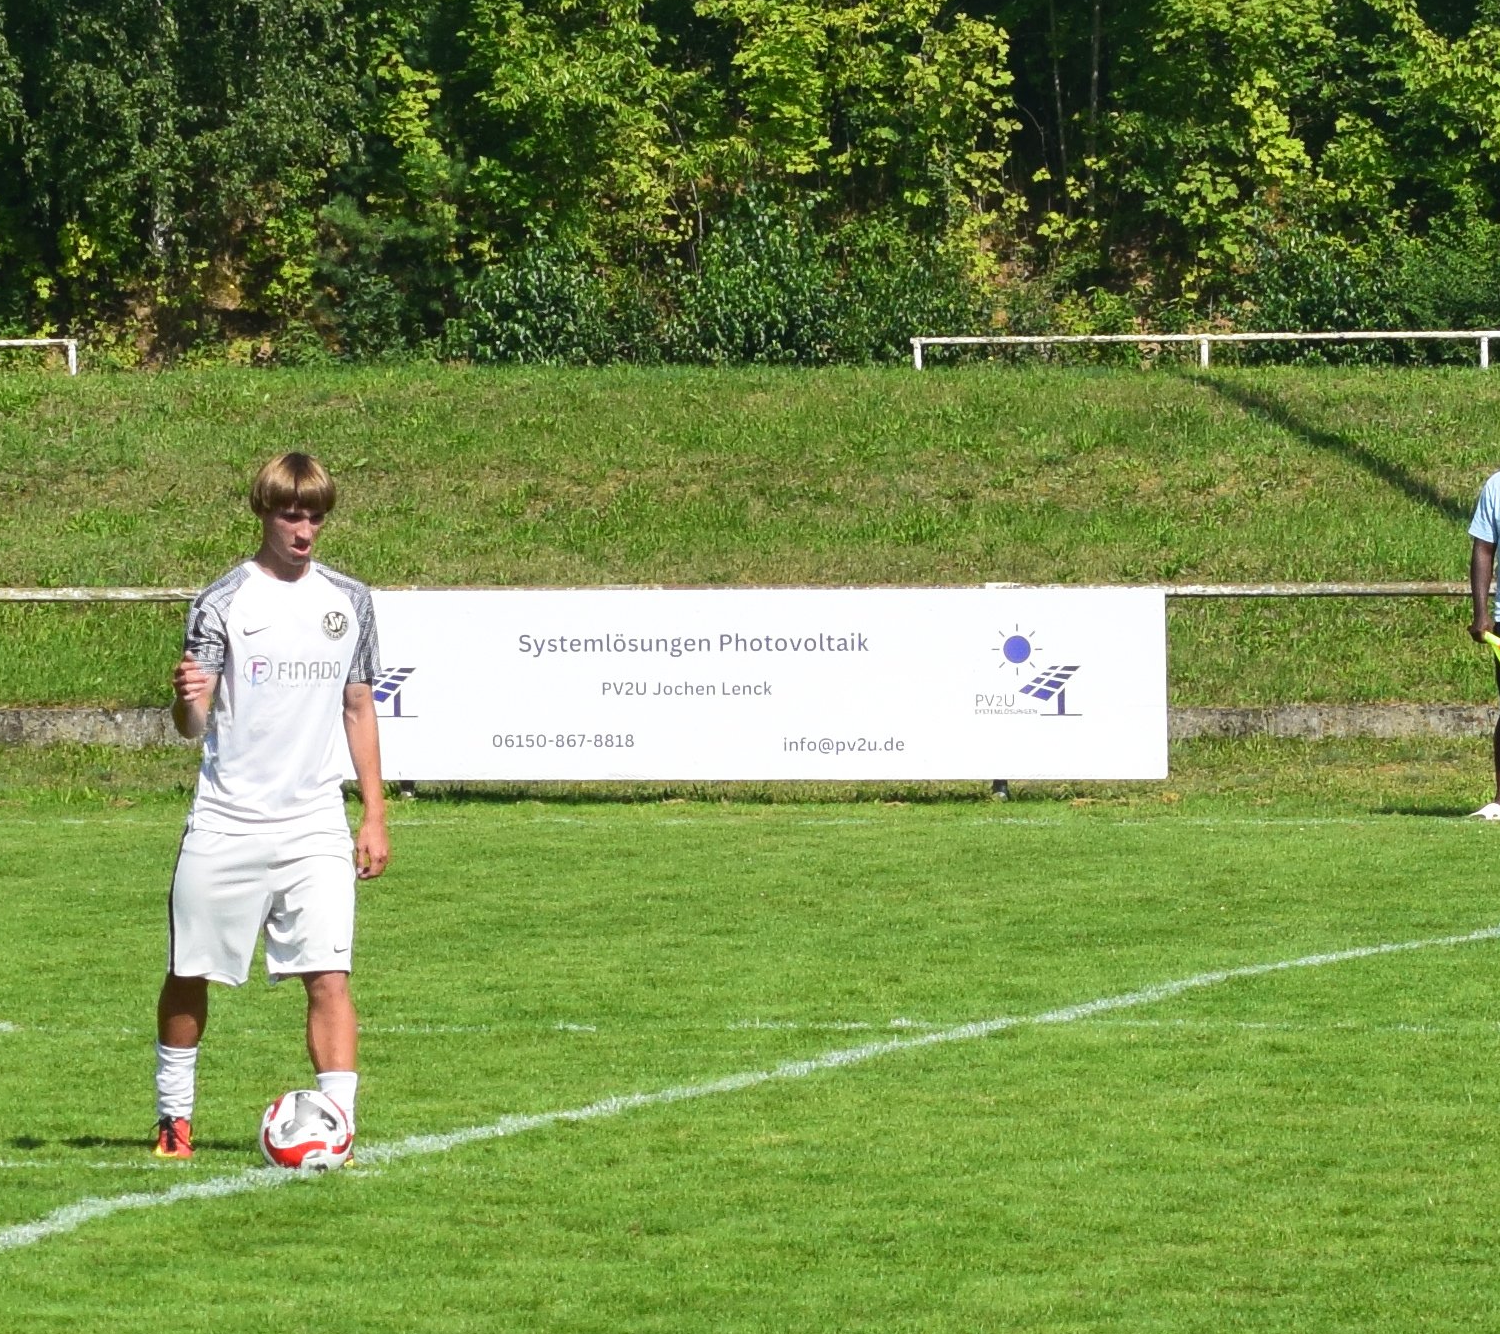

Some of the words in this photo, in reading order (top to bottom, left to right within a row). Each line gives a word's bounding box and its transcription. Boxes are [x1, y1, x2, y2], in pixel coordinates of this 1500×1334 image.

[518, 633, 711, 658] Systemlösungen
[719, 632, 869, 653] Photovoltaik
[277, 661, 342, 681] FINADO
[602, 682, 648, 696] PV2U
[653, 681, 717, 696] Jochen
[722, 681, 773, 696] Lenck
[975, 693, 1016, 708] PV2U
[492, 734, 635, 749] 06150-867-8818
[783, 737, 905, 755] info@pv2u.de
